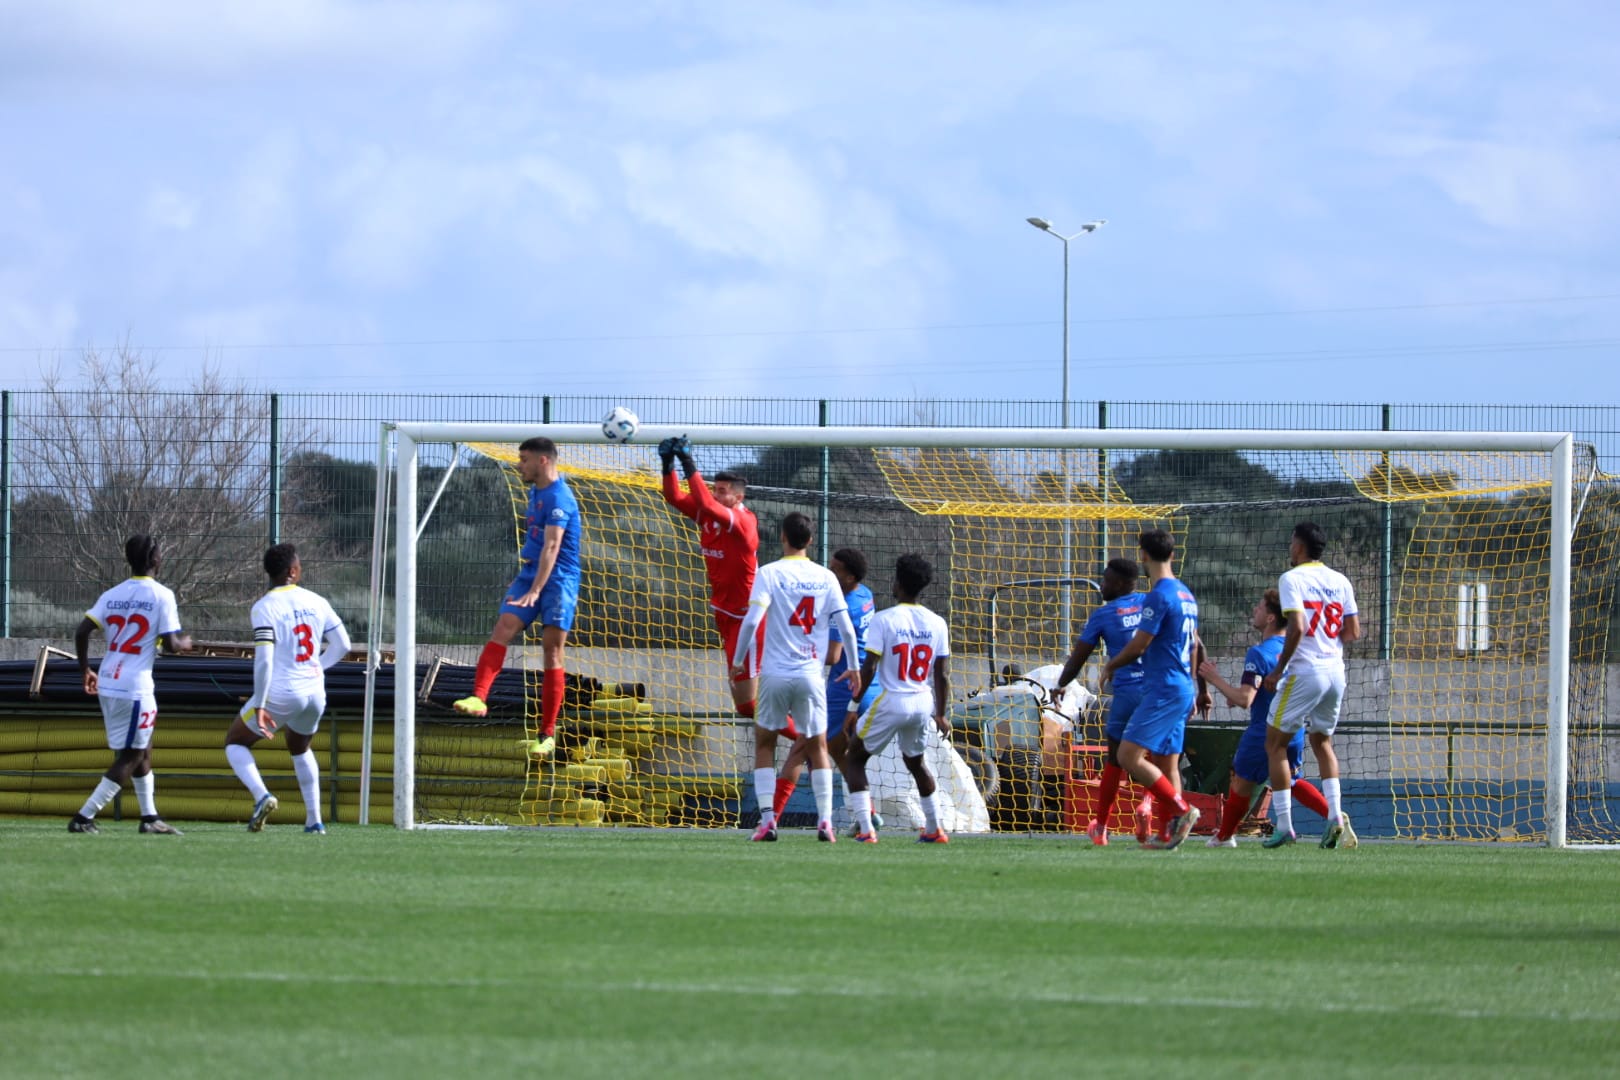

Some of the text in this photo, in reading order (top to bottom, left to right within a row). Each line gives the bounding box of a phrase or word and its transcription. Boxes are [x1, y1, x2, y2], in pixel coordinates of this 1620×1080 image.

[105, 612, 150, 655] 22
[788, 595, 817, 635] 4
[1302, 599, 1344, 639] 78
[292, 623, 314, 663] 3
[891, 642, 933, 683] 18
